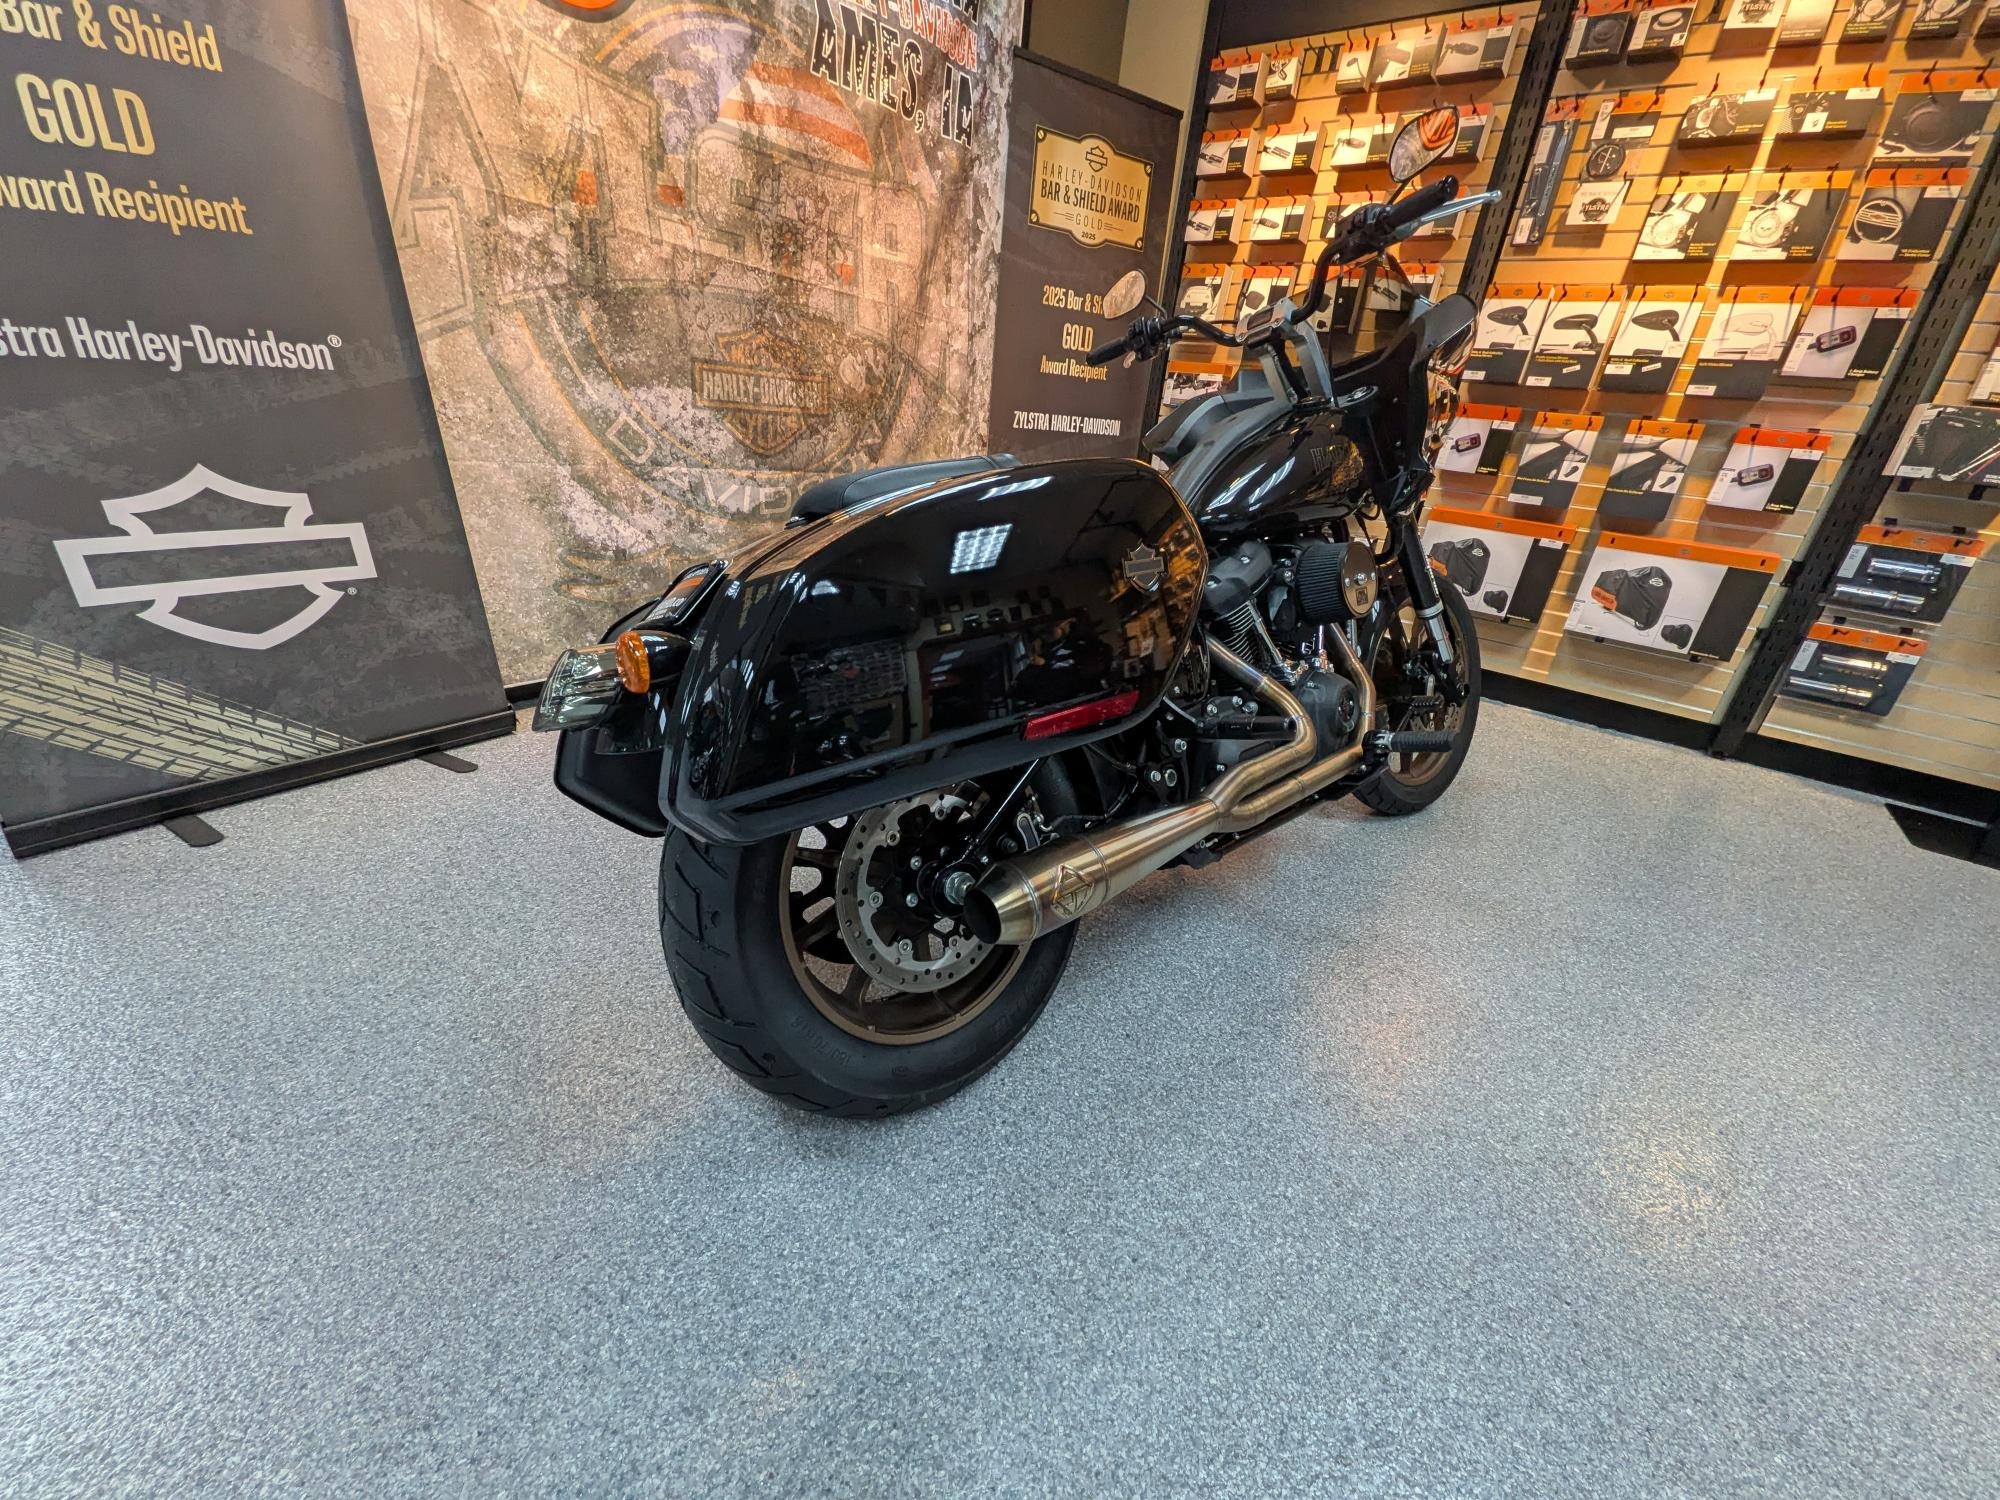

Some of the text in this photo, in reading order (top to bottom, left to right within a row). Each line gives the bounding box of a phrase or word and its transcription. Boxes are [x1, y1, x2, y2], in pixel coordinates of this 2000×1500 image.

[0, 0, 223, 73] Bar & Shield
[810, 0, 974, 149] AMES, IA
[15, 73, 156, 155] GOLD
[1040, 178, 1140, 223] BAR & SHIELD AWARD
[1042, 160, 1142, 202] HARLEY-DAVIDSON
[0, 169, 253, 236] ward Recipient
[1075, 213, 1103, 231] GOLD
[1081, 231, 1096, 241] 2025
[1042, 285, 1066, 308] 2025
[1067, 289, 1084, 311] Bar
[1084, 293, 1092, 313] &
[0, 318, 66, 358] tra
[1062, 322, 1094, 352] GOLD
[1040, 354, 1108, 382] Award Recipient
[1013, 410, 1121, 436] ZYLSTRA HARLEY-DAVIDSON
